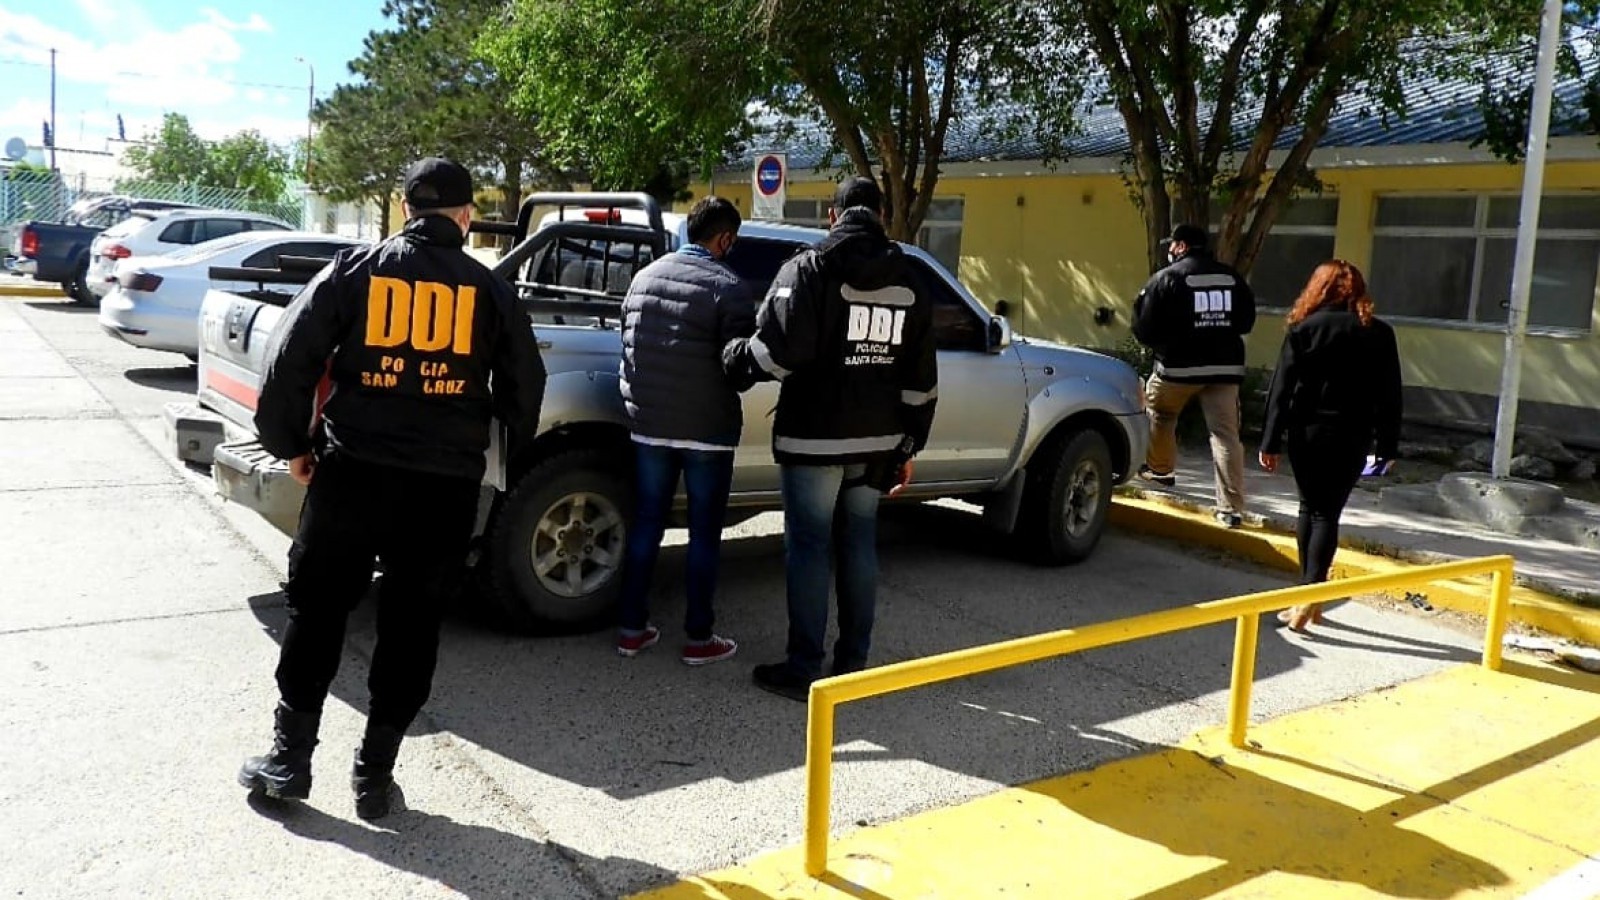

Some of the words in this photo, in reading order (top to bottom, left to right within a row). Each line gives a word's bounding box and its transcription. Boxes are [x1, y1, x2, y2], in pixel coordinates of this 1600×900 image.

[1194, 290, 1232, 313] DDI
[365, 275, 477, 355] DDI
[847, 304, 906, 346] DDI
[844, 356, 870, 366] SANTA
[361, 371, 398, 388] SAN
